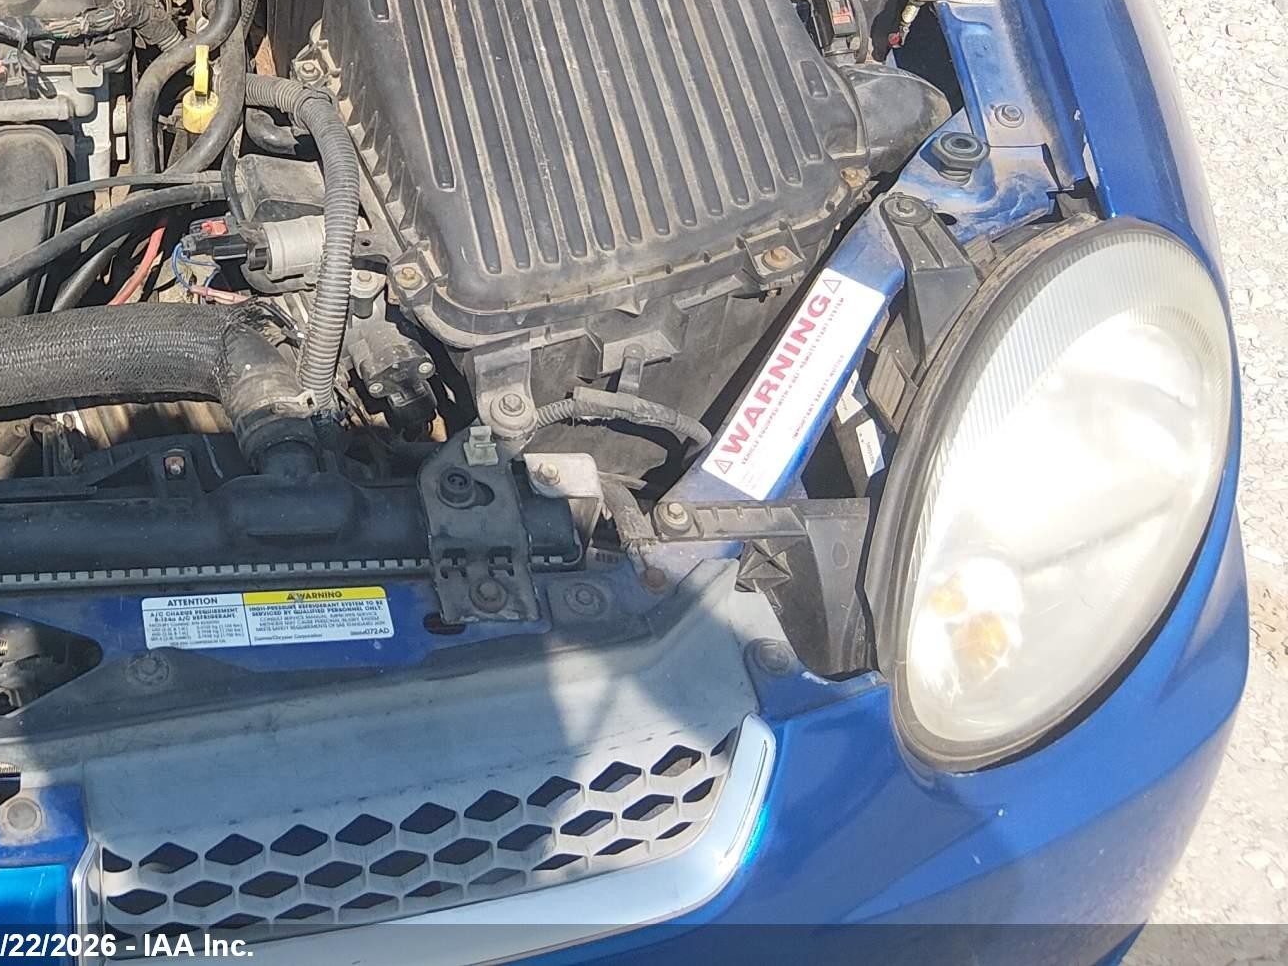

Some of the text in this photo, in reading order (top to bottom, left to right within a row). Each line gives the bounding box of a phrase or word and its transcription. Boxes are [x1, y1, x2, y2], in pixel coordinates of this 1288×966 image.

[721, 294, 832, 455] WARNING
[297, 590, 343, 600] WARNING
[167, 597, 218, 607] ATTENTION
